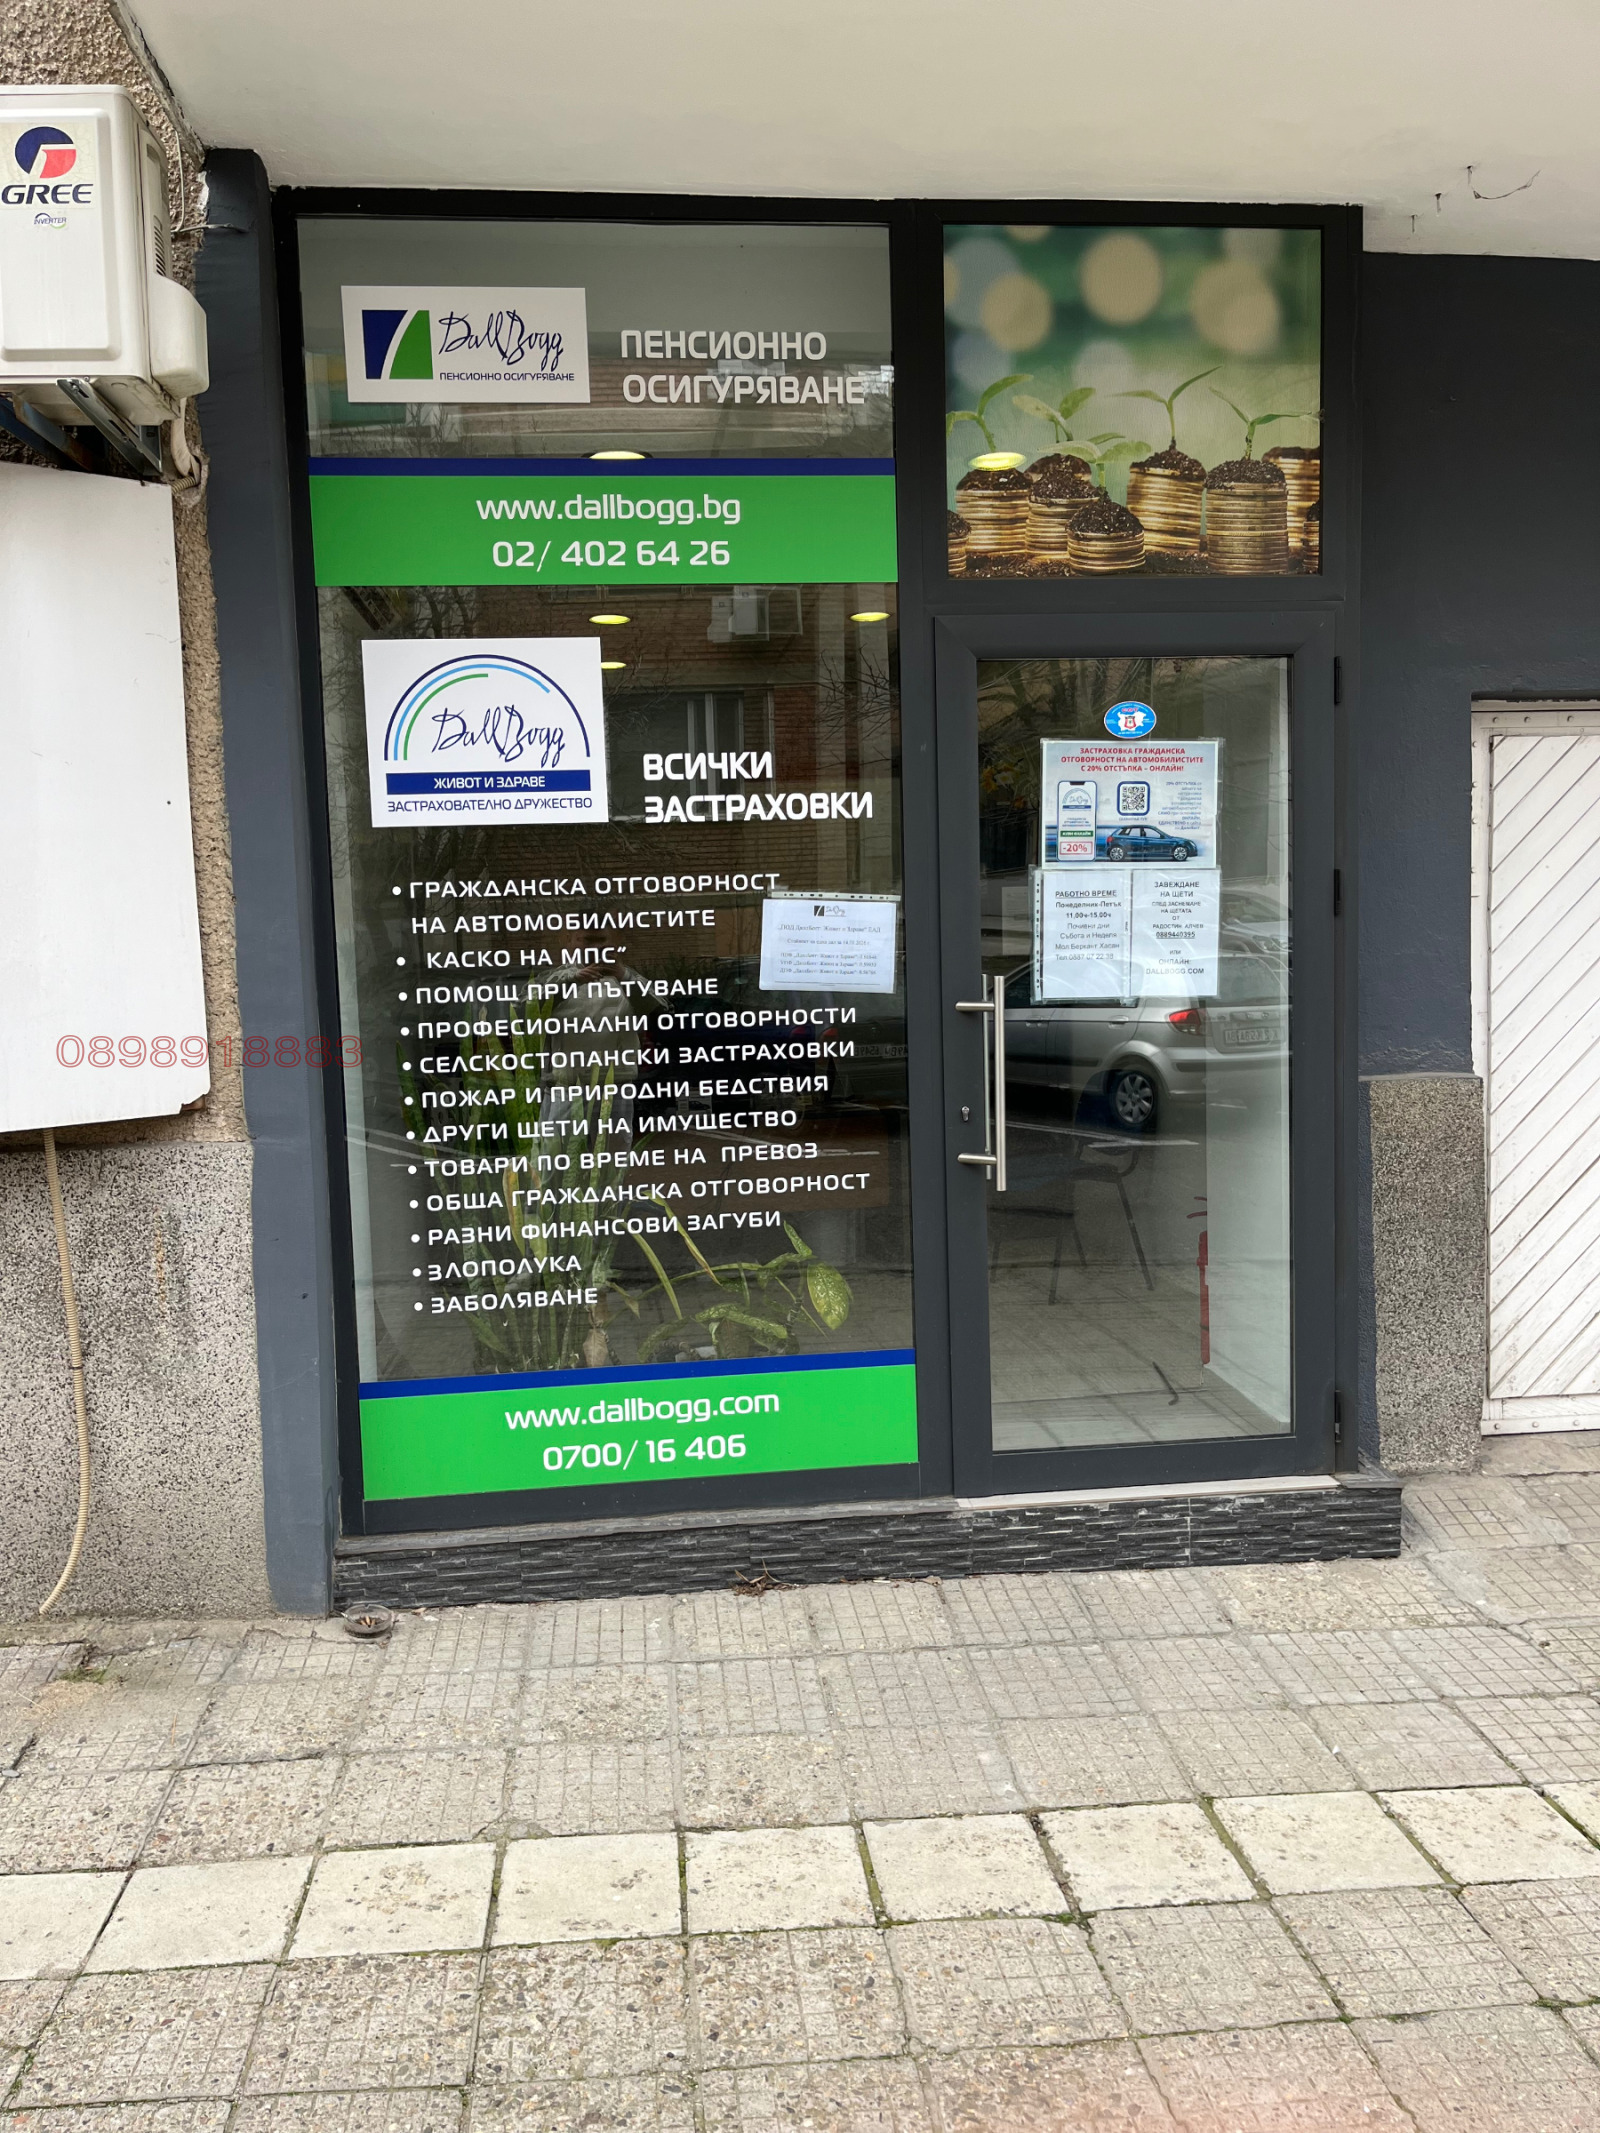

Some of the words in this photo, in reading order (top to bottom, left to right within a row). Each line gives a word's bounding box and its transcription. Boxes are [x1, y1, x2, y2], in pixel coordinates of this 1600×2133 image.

[1, 184, 93, 204] GREE
[621, 330, 826, 360] ПЕНСИОННО
[504, 373, 574, 381] ОСИГУРЯВАНЕ
[622, 374, 865, 405] ОСИГУРЯВАНЕ
[476, 494, 740, 524] www.dallbogg.bg
[493, 541, 551, 572] 02/
[561, 541, 626, 566] 402
[637, 541, 679, 565] 64
[690, 541, 729, 565] 26
[643, 752, 772, 780] ВСИЧКИ
[434, 777, 481, 789] ЖИВОТ
[484, 777, 494, 788] И
[497, 777, 545, 787] ЗДРАВЕ
[388, 799, 511, 812] ЗАСТРАХОВАТЕЛНО
[515, 798, 592, 809] ДРУЖЕСТВО
[645, 792, 872, 823] ЗАСТРАХОВКИ
[1063, 844, 1087, 852] -20%
[410, 879, 586, 898] ГРАЖДАНСКА
[595, 873, 780, 893] ОТГОВОРНОСТ
[412, 917, 446, 933] НА
[454, 910, 715, 932] АВТОМОБИЛИСТИТЕ
[427, 950, 510, 968] КАСКО
[521, 949, 552, 965] НА
[417, 985, 519, 1003] ПОМОЩ
[528, 983, 577, 1000] ПРИ
[588, 979, 717, 998] ПЪТУВАНЕ
[419, 1015, 647, 1038] ПРОФЕСИОНАЛНИ
[658, 1008, 855, 1029] ОТГОВОРНОСТИ
[420, 1048, 669, 1073] СЕЛСКОСТОПАНСКИ
[679, 1041, 854, 1063] ЗАСТРАХОВКИ
[422, 1089, 515, 1108] ПОЖАР
[526, 1088, 541, 1103] И
[551, 1081, 689, 1102] ПРИРОДНИ
[700, 1076, 828, 1096] БЕДСТВИЯ
[423, 1123, 507, 1142] ДРУГИ
[518, 1120, 588, 1138] ЩЕТИ
[598, 1118, 630, 1134] НА
[639, 1110, 796, 1132] ИМУЩЕСТВО
[424, 1156, 527, 1177] ТОВАРИ
[538, 1155, 570, 1171] ПО
[581, 1150, 665, 1169] ВРЕМЕ
[675, 1148, 706, 1164] НА
[722, 1143, 817, 1162] ПРЕВОЗ
[427, 1192, 503, 1211] ОБЩА
[512, 1183, 682, 1206] ГРАЖДАНСКА
[691, 1173, 869, 1197] ОТГОВОРНОСТ
[429, 1226, 511, 1245] РАЗНИ
[522, 1216, 677, 1239] ФИНАНСОВИ
[688, 1211, 780, 1230] ЗАГУБИ
[428, 1256, 581, 1281] ЗЛОПОЛУКА
[431, 1288, 597, 1313] ЗАБОЛЯВАНЕ
[505, 1394, 779, 1429] www.dallbogg.com
[543, 1440, 638, 1470] 0700/
[646, 1439, 676, 1463] 16
[685, 1434, 746, 1459] 406
